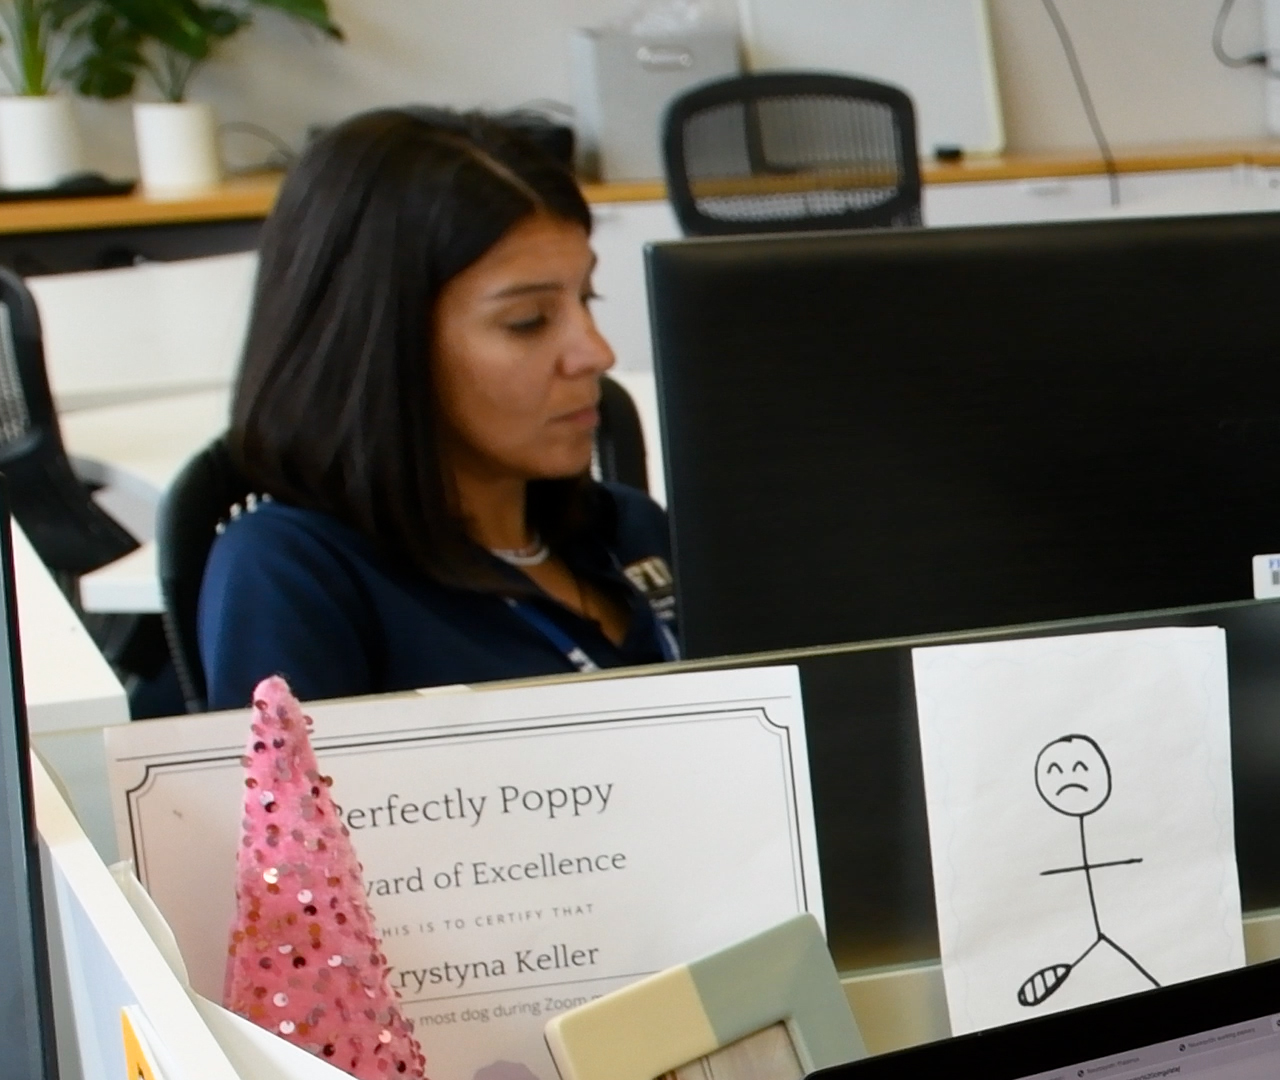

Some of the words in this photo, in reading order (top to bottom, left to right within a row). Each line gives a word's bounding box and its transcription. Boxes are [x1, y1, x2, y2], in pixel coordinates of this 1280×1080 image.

[499, 779, 615, 821] Poppy
[366, 867, 424, 897] ard
[433, 861, 465, 890] of
[472, 848, 628, 887] Excellence
[376, 924, 411, 938] HIS
[419, 923, 436, 934] IS
[445, 918, 466, 931] TO
[475, 909, 544, 928] CERTIFY
[552, 903, 595, 918] THAT
[515, 943, 600, 974] Keller
[420, 1010, 457, 1027] most
[461, 1004, 490, 1022] dog
[493, 998, 542, 1017] during
[544, 995, 588, 1011] Zoom
